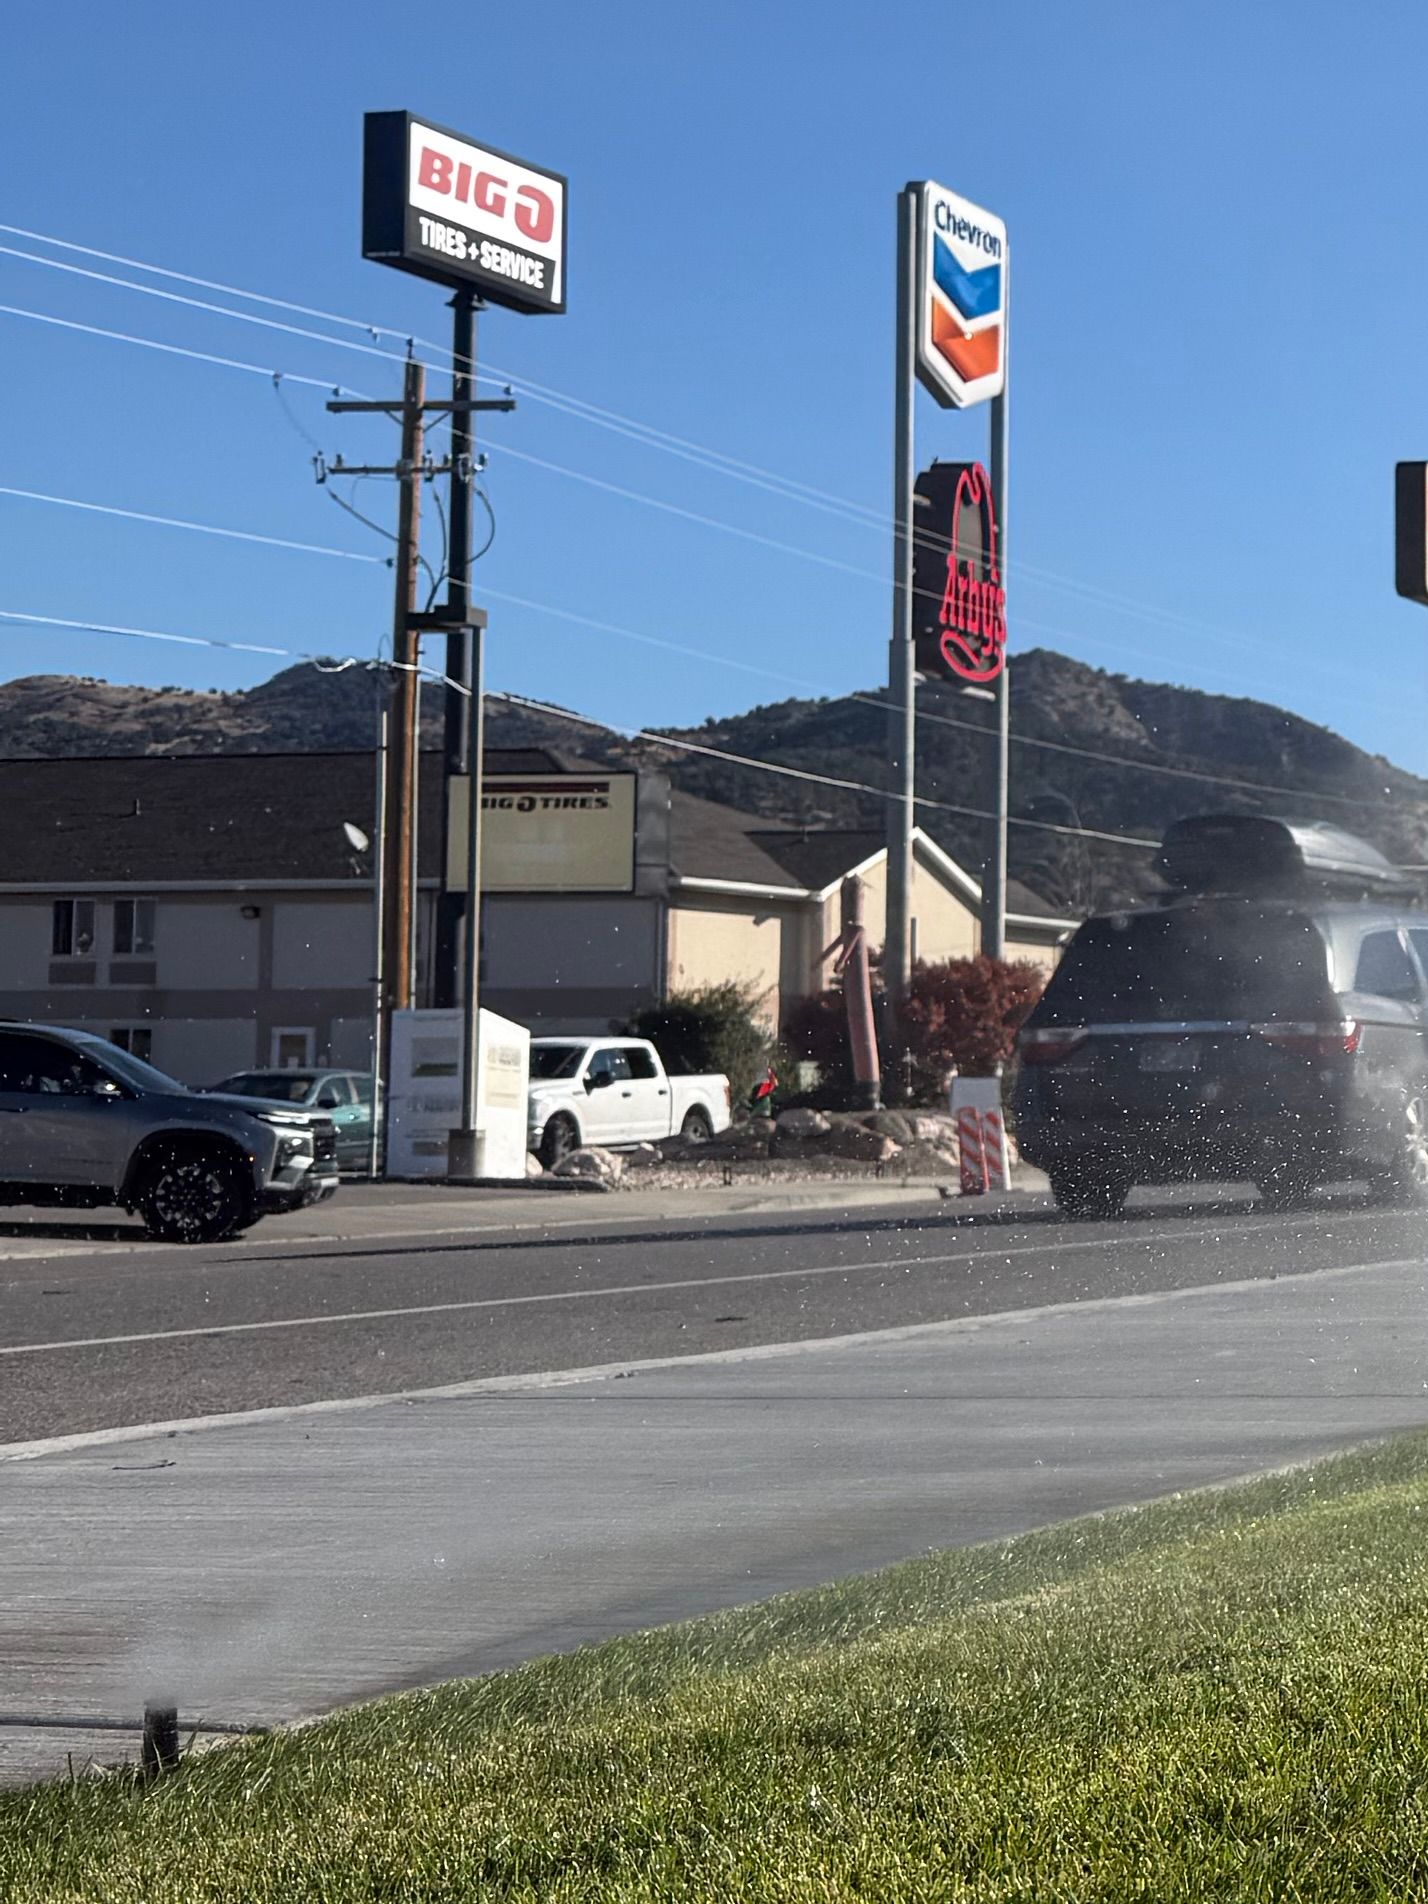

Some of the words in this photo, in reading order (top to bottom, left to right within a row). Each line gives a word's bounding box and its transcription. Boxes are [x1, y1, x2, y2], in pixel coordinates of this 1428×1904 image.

[418, 146, 508, 218] BIG
[418, 216, 467, 260] TIRES
[480, 240, 545, 290] SERVICE
[934, 199, 1002, 259] Chevron
[541, 797, 610, 810] TIRES
